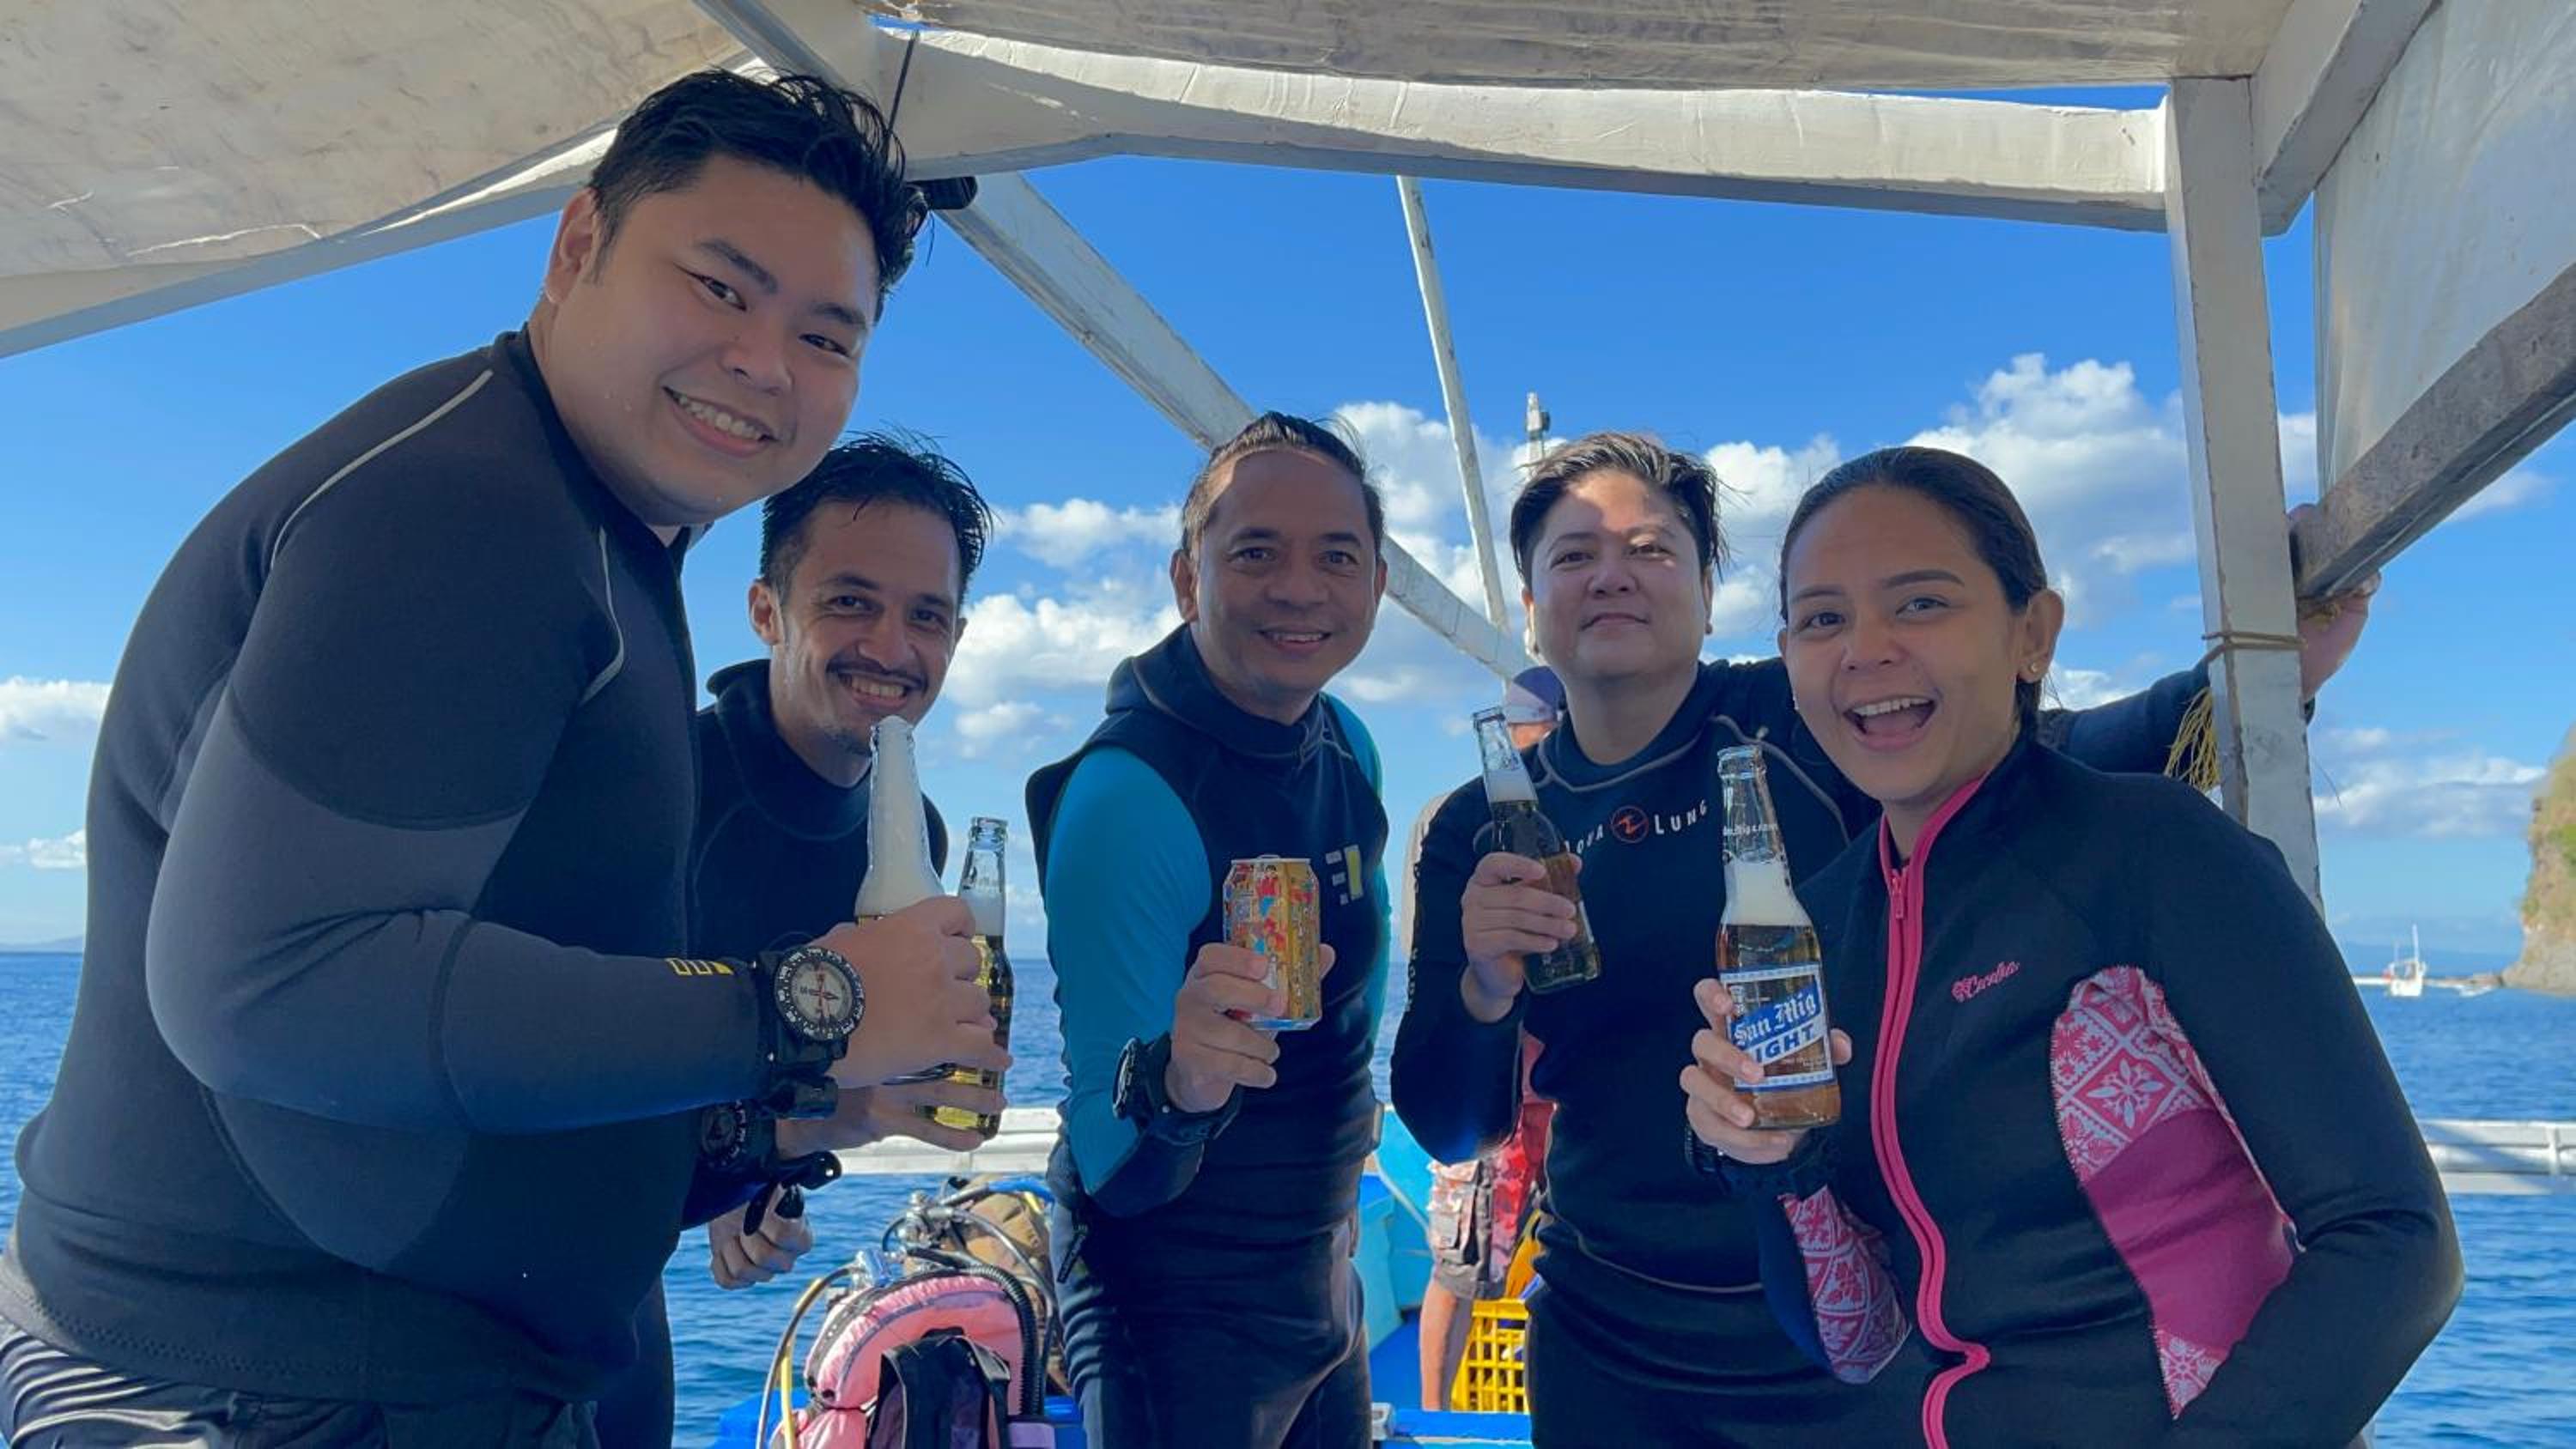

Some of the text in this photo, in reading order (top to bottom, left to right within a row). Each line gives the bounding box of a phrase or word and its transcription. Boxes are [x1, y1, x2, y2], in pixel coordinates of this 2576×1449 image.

[1654, 800, 1707, 835] LUNG
[1734, 1017, 1771, 1046] San
[1773, 992, 1816, 1029] Mig
[1755, 1022, 1815, 1064] IGHT
